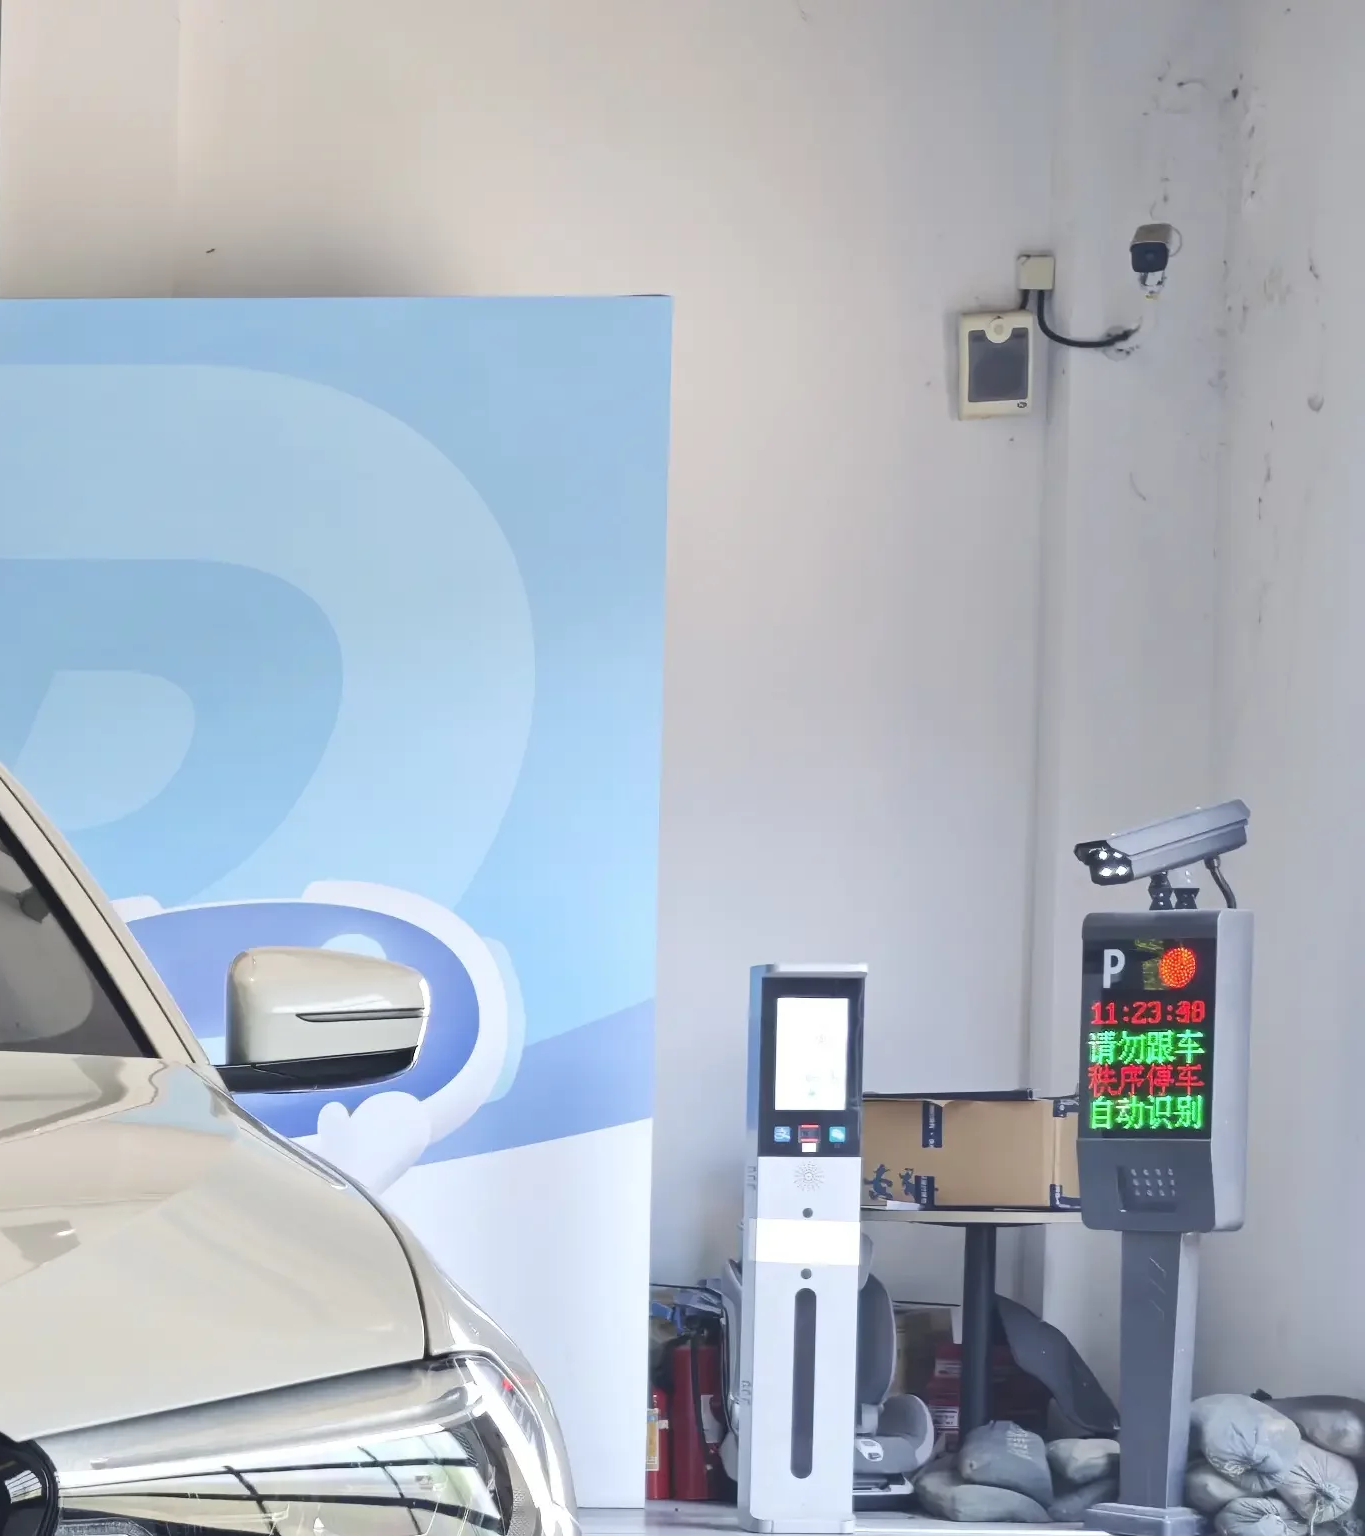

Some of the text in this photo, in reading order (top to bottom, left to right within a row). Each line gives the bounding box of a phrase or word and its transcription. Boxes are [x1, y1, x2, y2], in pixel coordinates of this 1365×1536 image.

[1102, 948, 1126, 989] P
[1088, 1029, 1205, 1064] 请勿跟车
[1089, 1095, 1204, 1130] 自动识别
